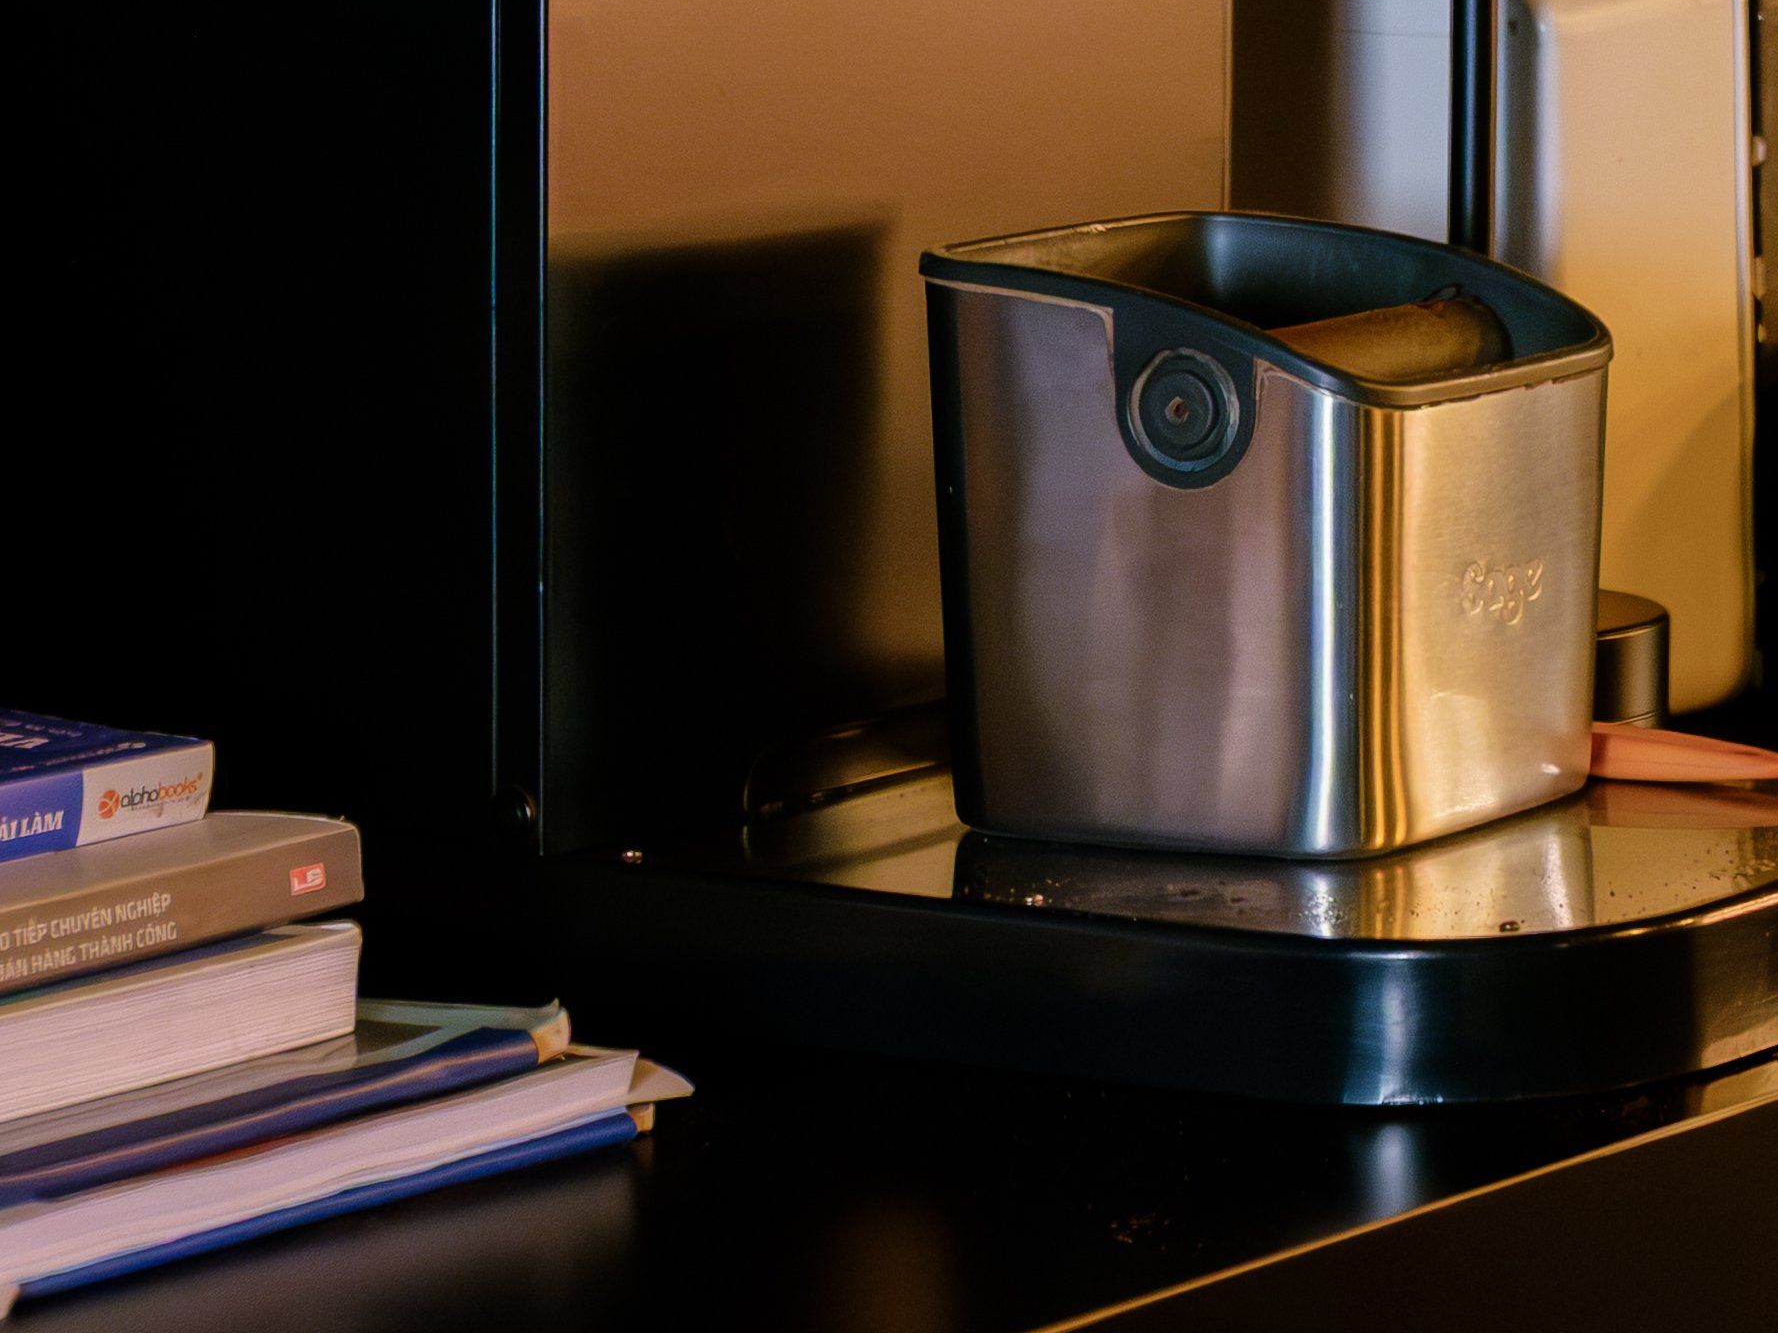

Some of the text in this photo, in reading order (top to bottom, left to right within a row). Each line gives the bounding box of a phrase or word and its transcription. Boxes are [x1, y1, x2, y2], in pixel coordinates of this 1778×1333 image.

[20, 810, 65, 838] LÀM
[51, 907, 113, 939] CHUYÊN
[115, 892, 172, 924] NGHIỆP
[31, 946, 77, 974] HÀNG
[79, 933, 134, 961] THÀNH
[136, 921, 178, 949] CÔNG
